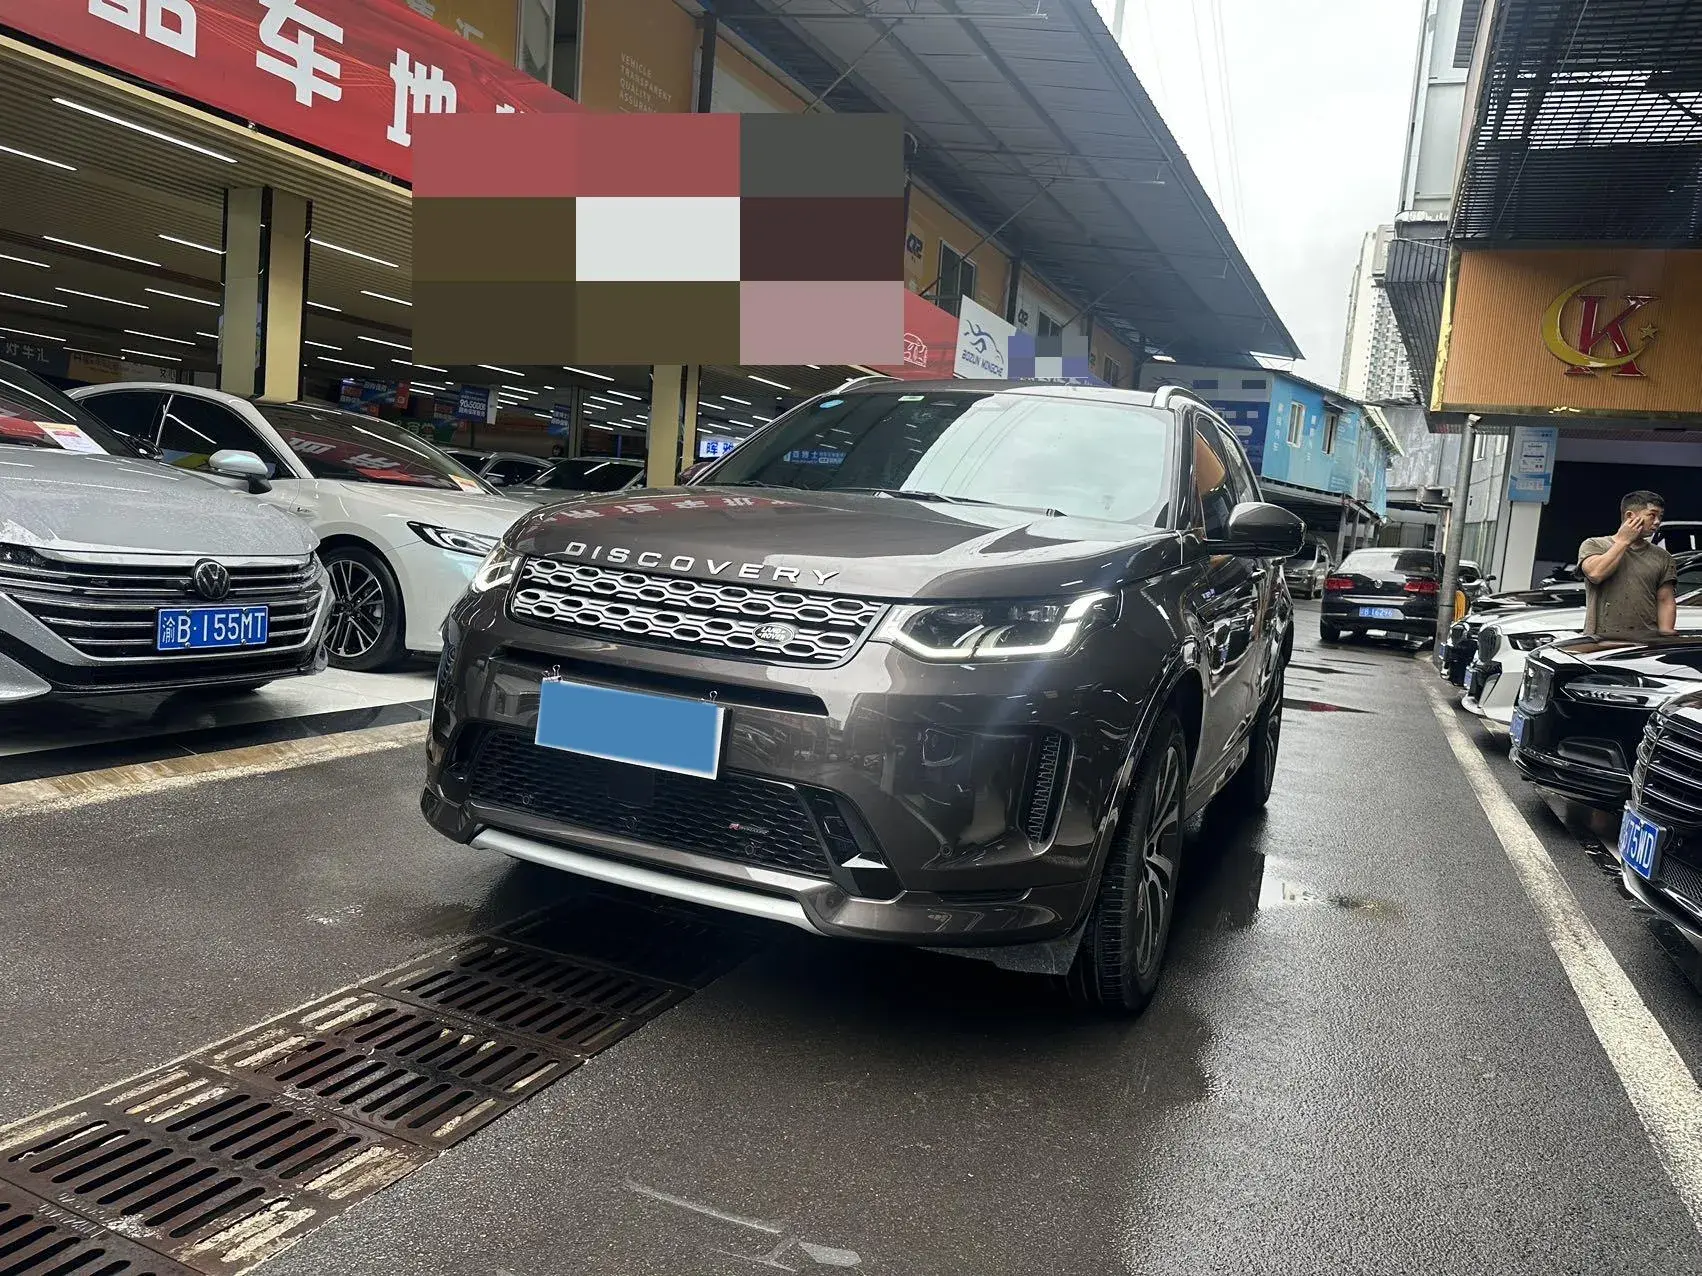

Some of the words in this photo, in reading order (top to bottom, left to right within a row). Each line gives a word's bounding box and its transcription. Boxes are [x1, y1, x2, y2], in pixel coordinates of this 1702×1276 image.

[621, 51, 653, 79] VEHICLE
[620, 78, 652, 102] QUALITY
[621, 64, 672, 104] TRANSPARENT
[1564, 294, 1661, 378] K
[564, 541, 840, 585] DISCOVERY
[760, 632, 786, 641] ROVER
